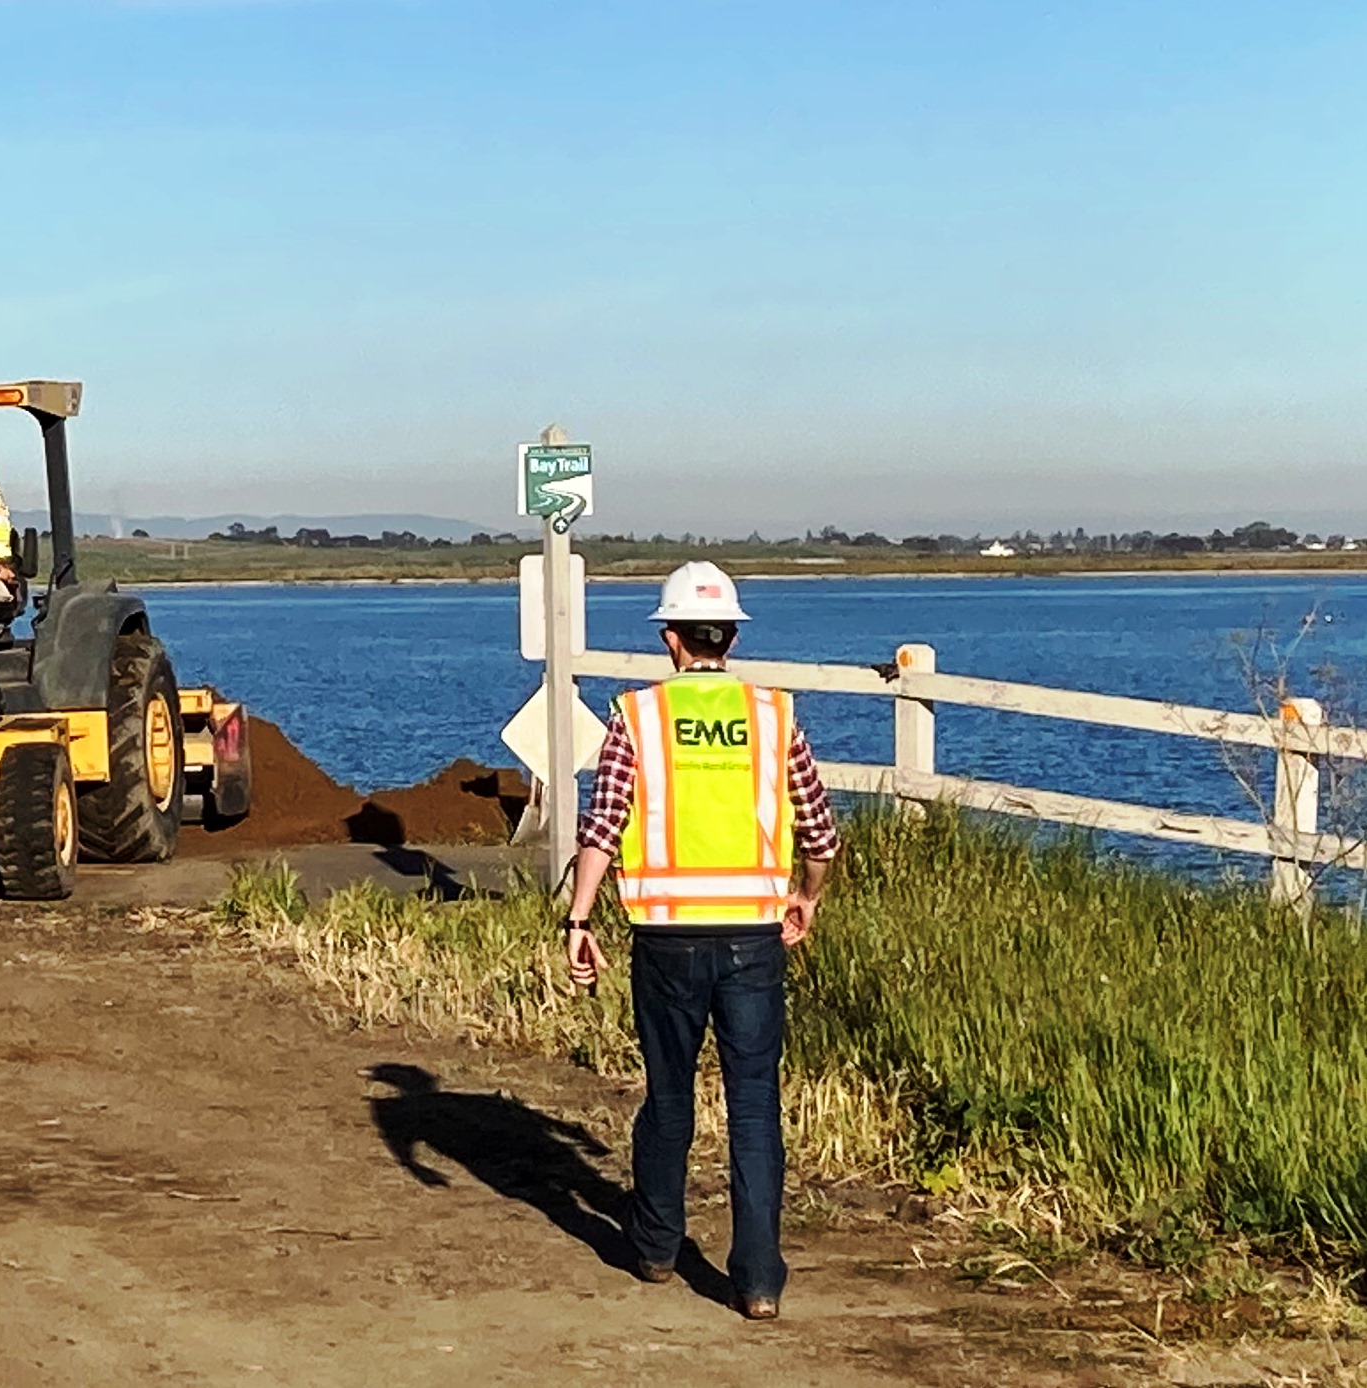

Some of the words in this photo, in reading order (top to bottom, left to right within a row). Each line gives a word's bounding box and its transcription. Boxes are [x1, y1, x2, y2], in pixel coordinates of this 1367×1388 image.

[530, 458, 556, 477] Bay
[557, 456, 589, 472] Trail
[674, 718, 748, 747] EMG
